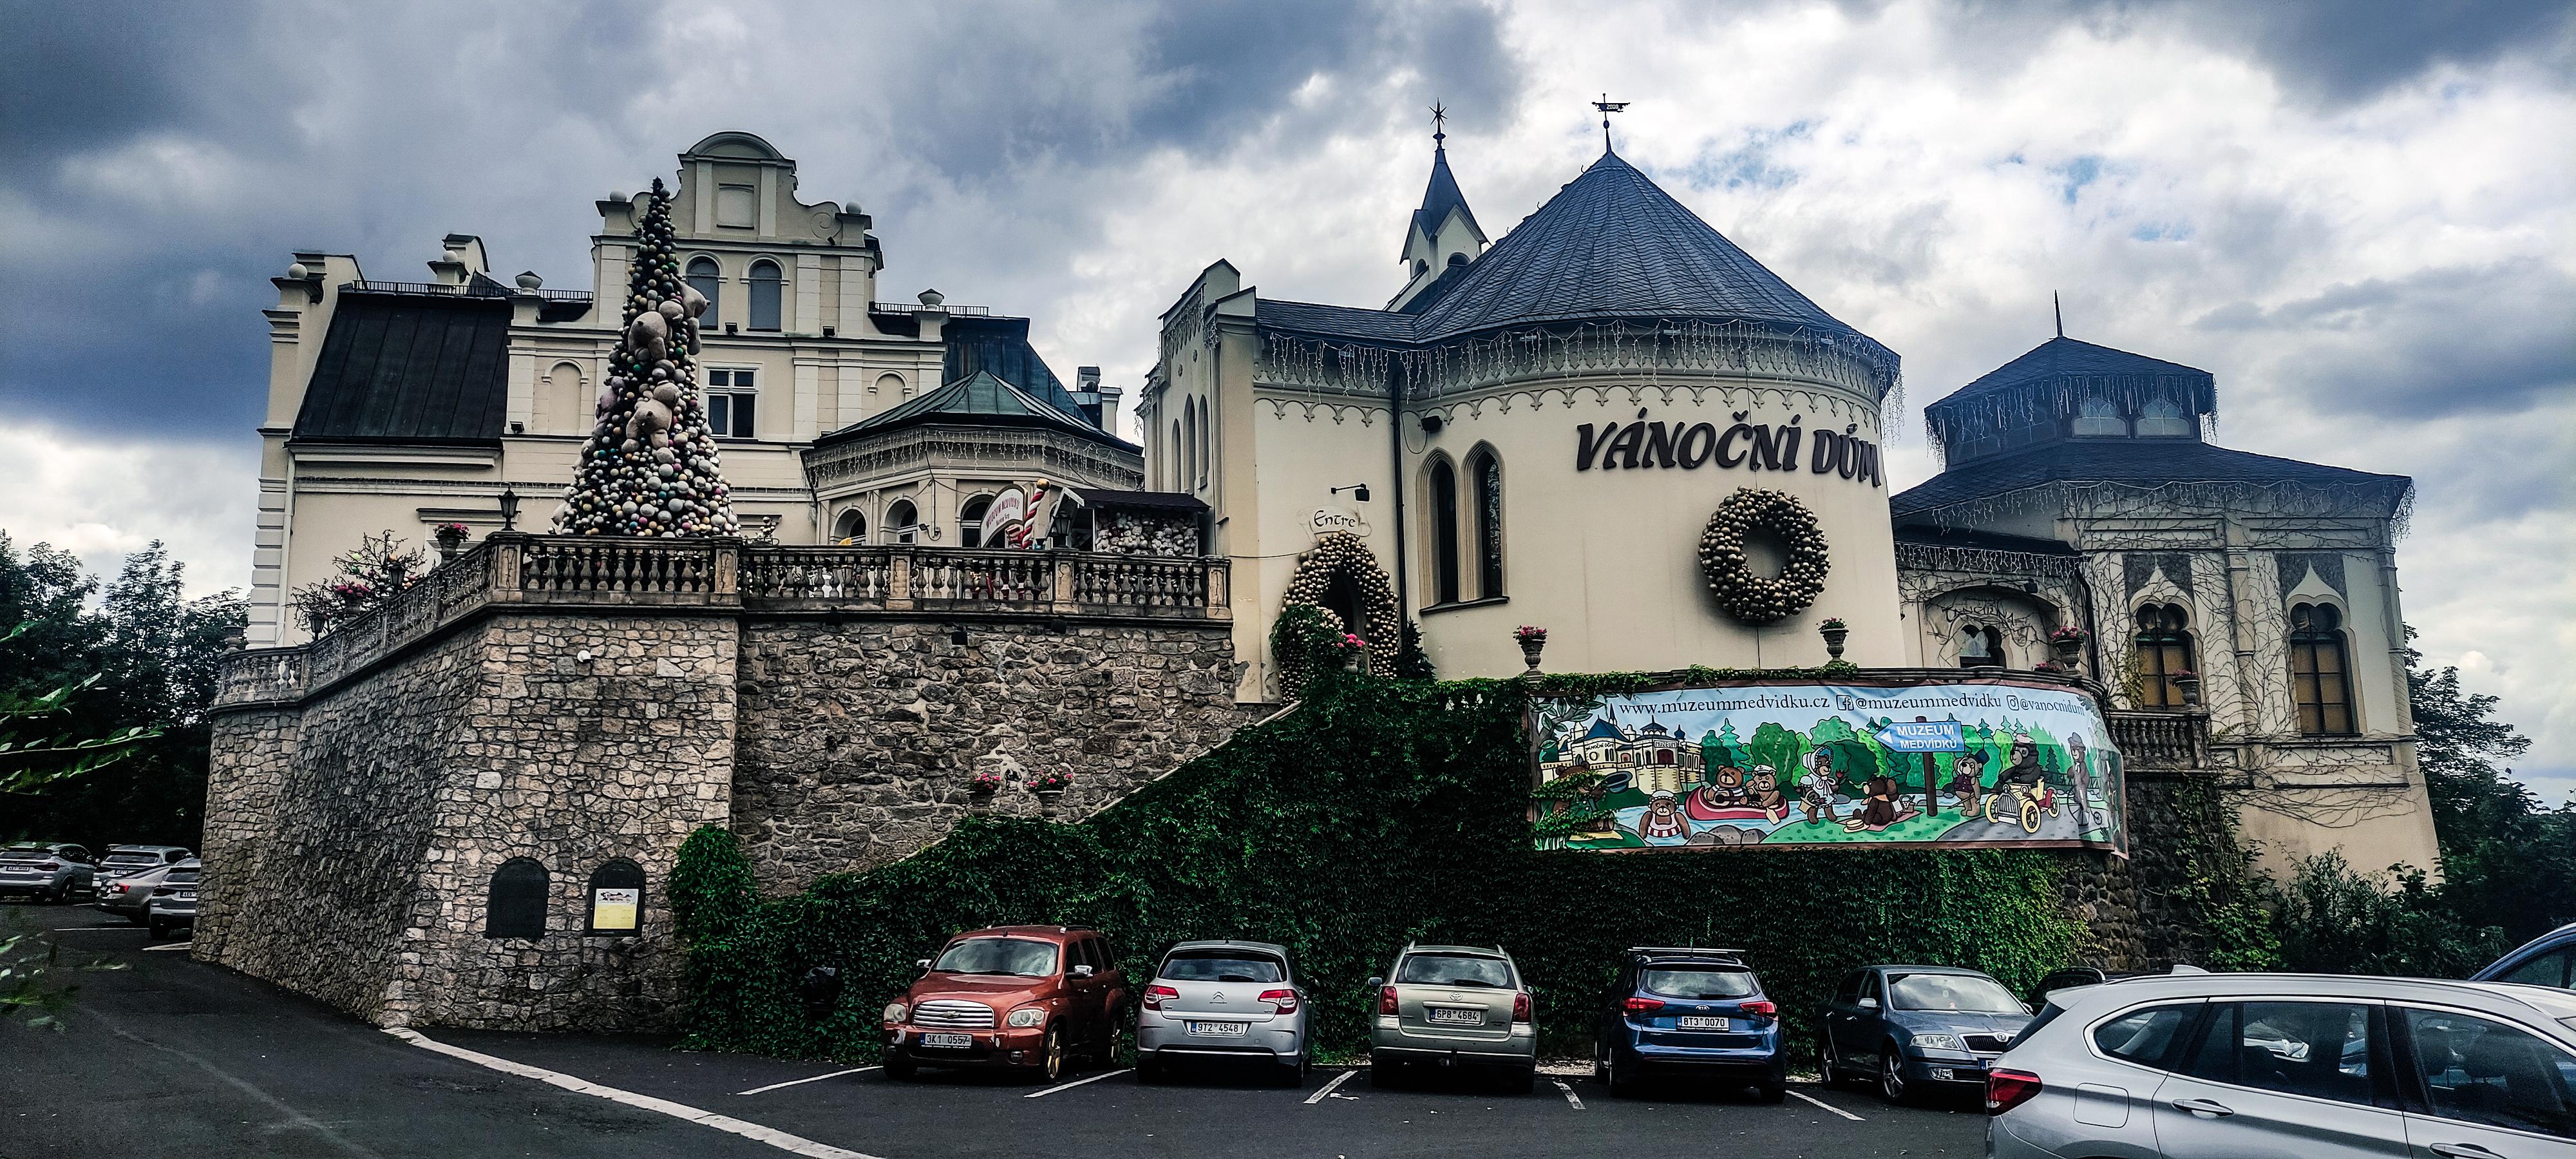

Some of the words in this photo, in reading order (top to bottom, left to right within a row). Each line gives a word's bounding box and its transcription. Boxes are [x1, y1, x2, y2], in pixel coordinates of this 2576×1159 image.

[1577, 407, 1802, 471] VÁNOČNÍ
[1812, 423, 1882, 488] DŮM
[1618, 694, 1830, 714] www.muzeummedvidku.cz
[1855, 693, 2002, 709] @muzeummedvidku
[2020, 698, 2085, 716] @vanocnidum
[1896, 724, 1955, 736] MUZEUM
[1900, 738, 1957, 749] MEDVÍDKŮ
[1437, 1010, 1452, 1019] 6P8
[1457, 1011, 1477, 1020] 4684
[1683, 1017, 1699, 1026] 8T3
[1705, 1018, 1725, 1026] 0070
[1198, 1023, 1213, 1031] 9T2
[1218, 1024, 1238, 1032] 4548
[927, 1035, 942, 1044] 3K1
